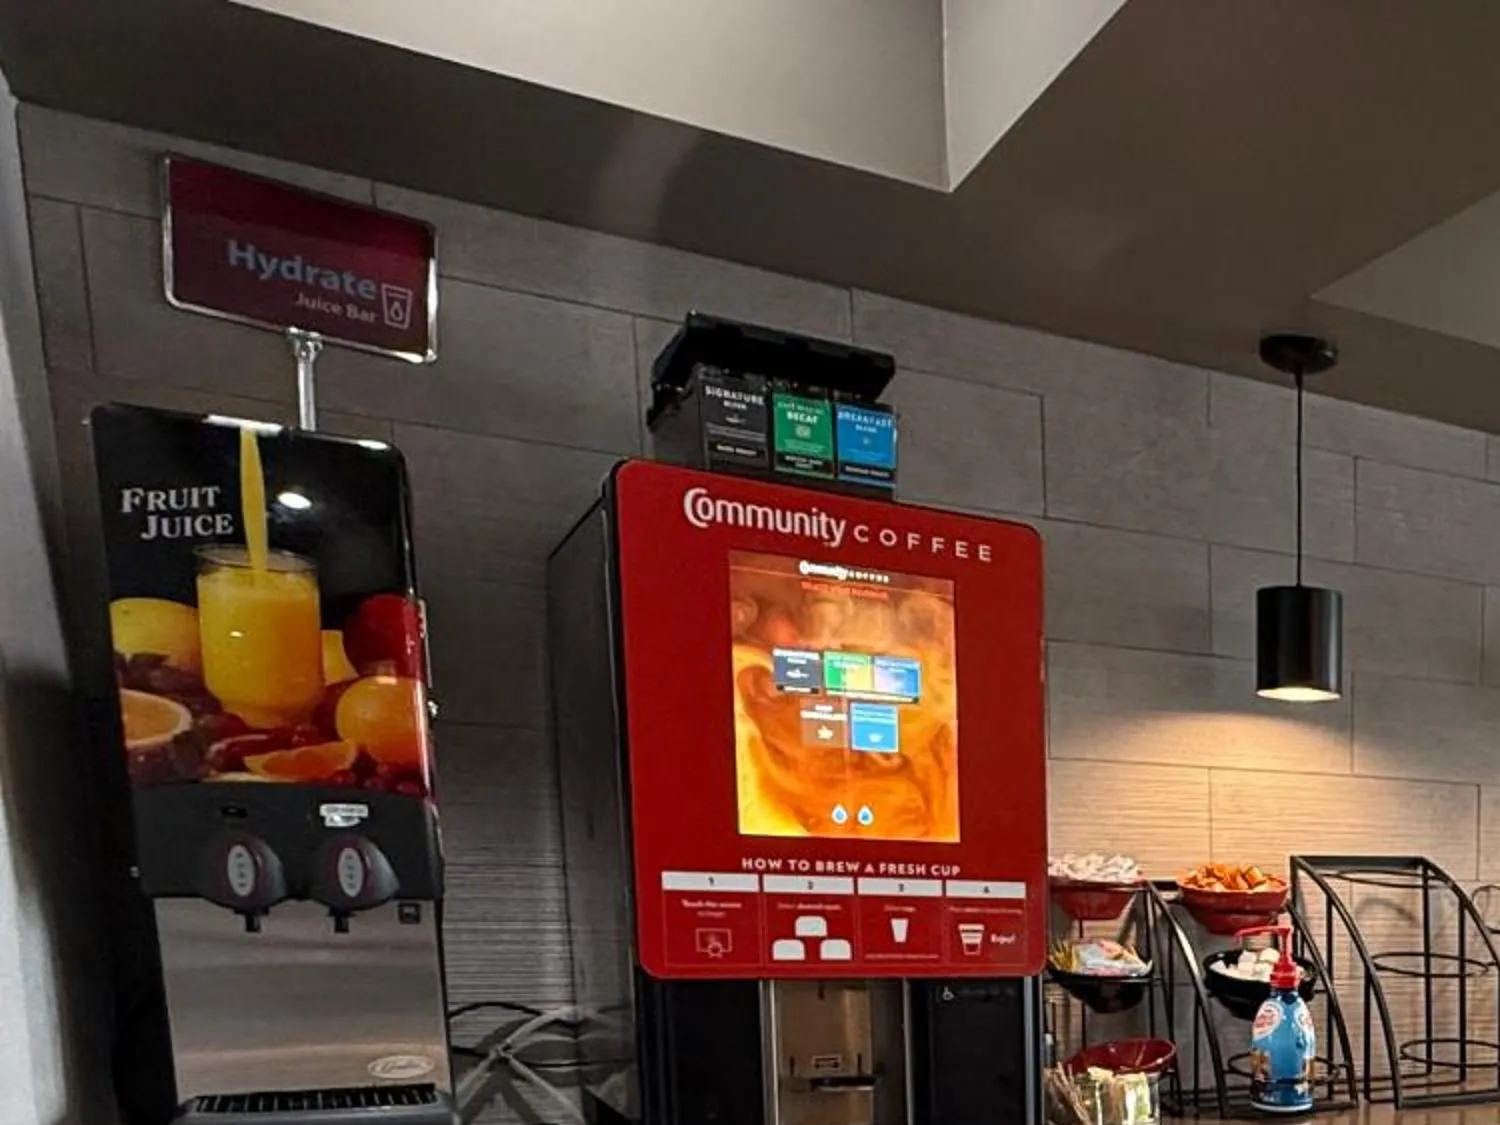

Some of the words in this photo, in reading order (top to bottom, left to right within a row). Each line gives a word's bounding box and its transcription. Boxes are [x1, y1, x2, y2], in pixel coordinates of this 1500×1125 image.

[226, 239, 378, 299] Hydrate
[296, 292, 342, 316] Juice
[346, 302, 378, 323] Bar
[705, 385, 765, 405] SIGNATURE
[786, 411, 819, 425] DECAF
[121, 486, 221, 513] FRUIT
[140, 513, 234, 540] JUICE
[683, 487, 847, 547] Community
[853, 524, 992, 562] COFFEE
[741, 858, 782, 870] HOW
[787, 859, 810, 871] TO
[815, 860, 860, 873] BREW
[864, 863, 875, 873] A
[879, 863, 926, 875] FRESH
[930, 865, 961, 876] CUP
